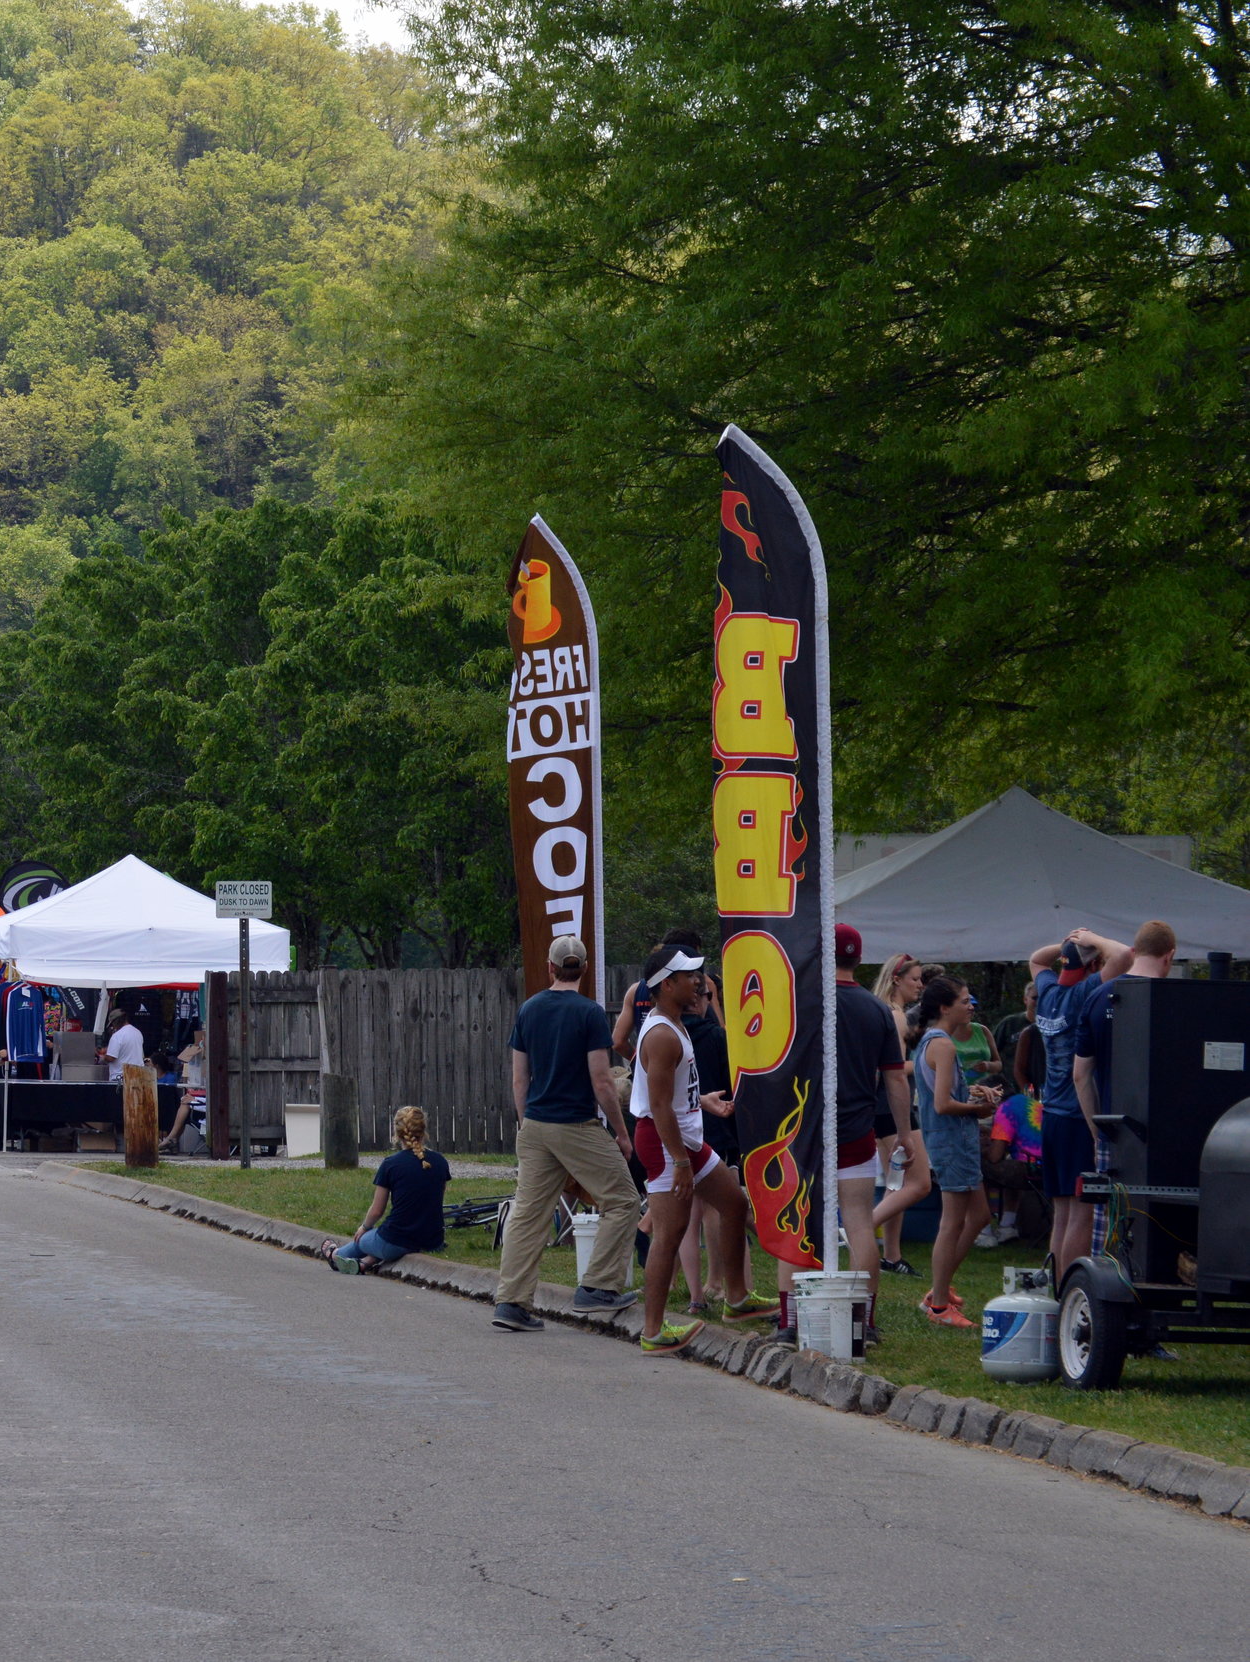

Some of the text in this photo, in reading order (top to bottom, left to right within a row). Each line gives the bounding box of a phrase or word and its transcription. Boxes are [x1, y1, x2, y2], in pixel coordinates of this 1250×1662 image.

[219, 884, 269, 895] PARK CLOSED
[219, 898, 268, 906] DUSK TO DAWN
